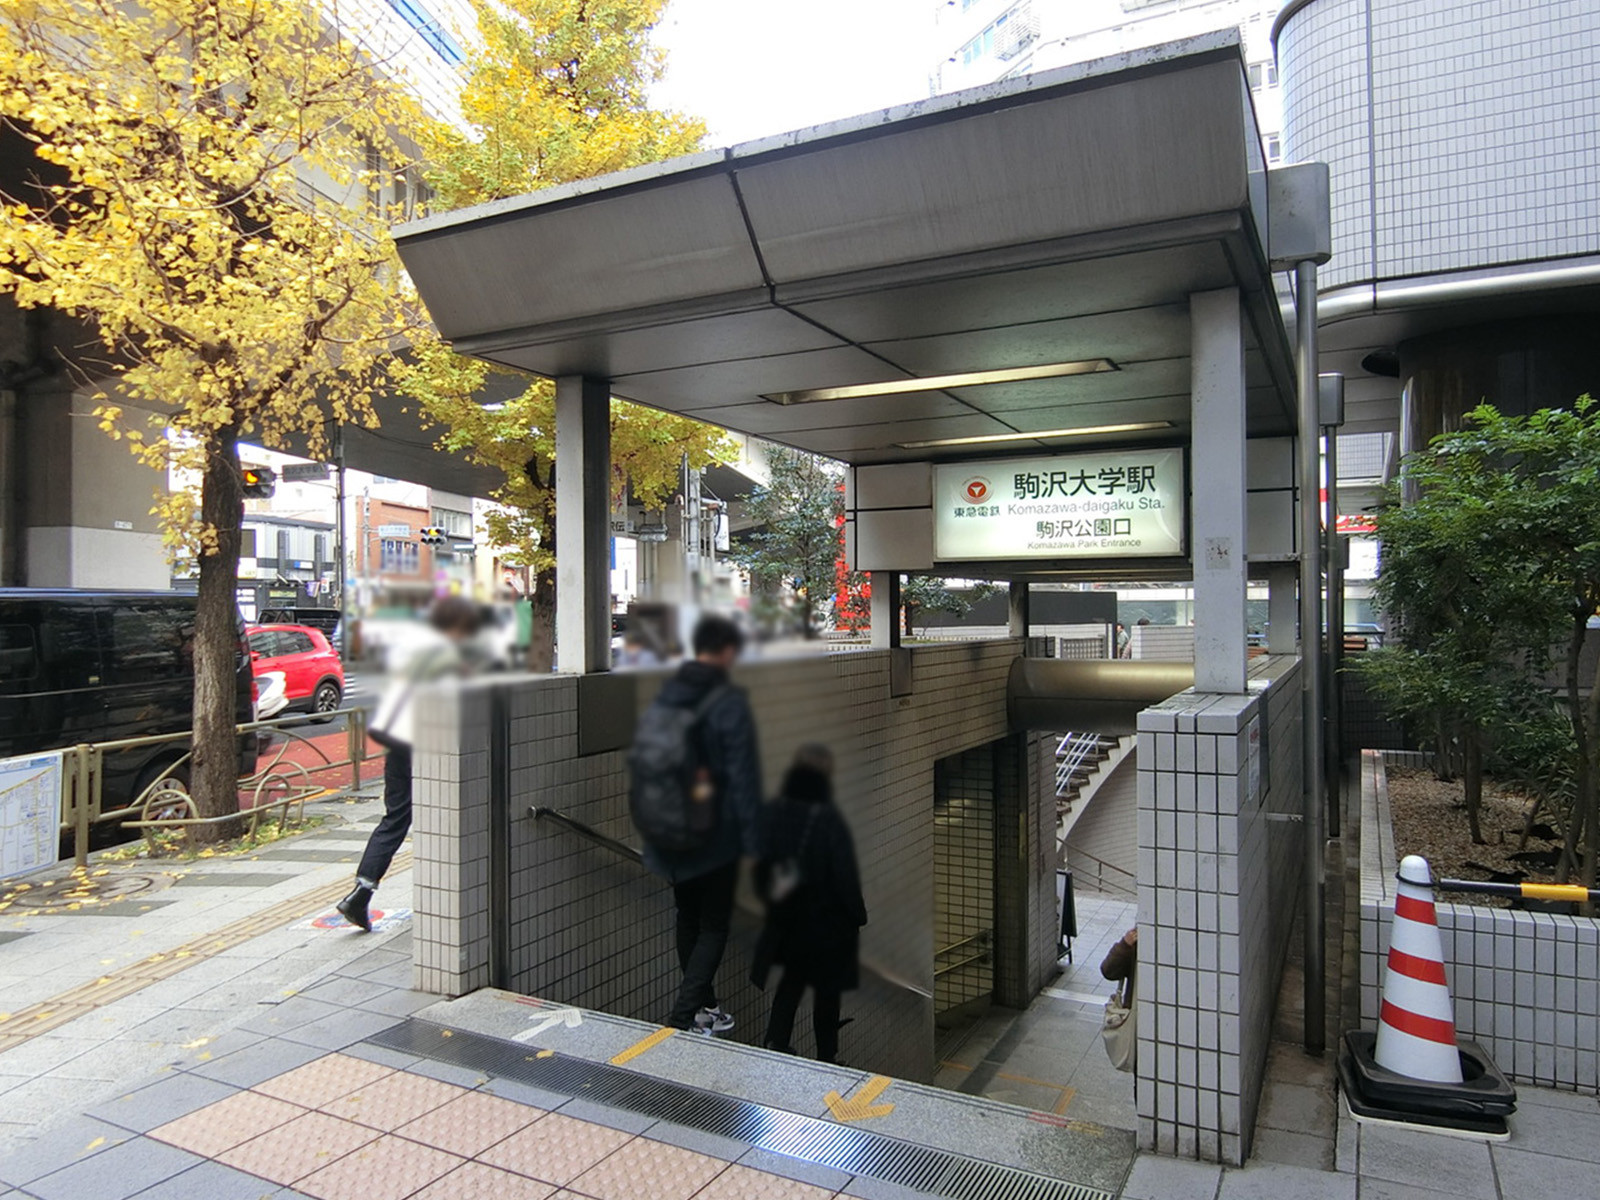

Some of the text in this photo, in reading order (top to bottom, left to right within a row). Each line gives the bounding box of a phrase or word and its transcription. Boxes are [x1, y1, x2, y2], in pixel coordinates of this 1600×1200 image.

[1014, 465, 1156, 499] 駒沢大学駅
[954, 506, 1000, 518] 東急電鉄
[1007, 496, 1166, 515] Komazawa-daigaku Sta.
[1036, 518, 1131, 539] 駒沢公園口
[1027, 538, 1142, 550] Komazawa Park Entrance
